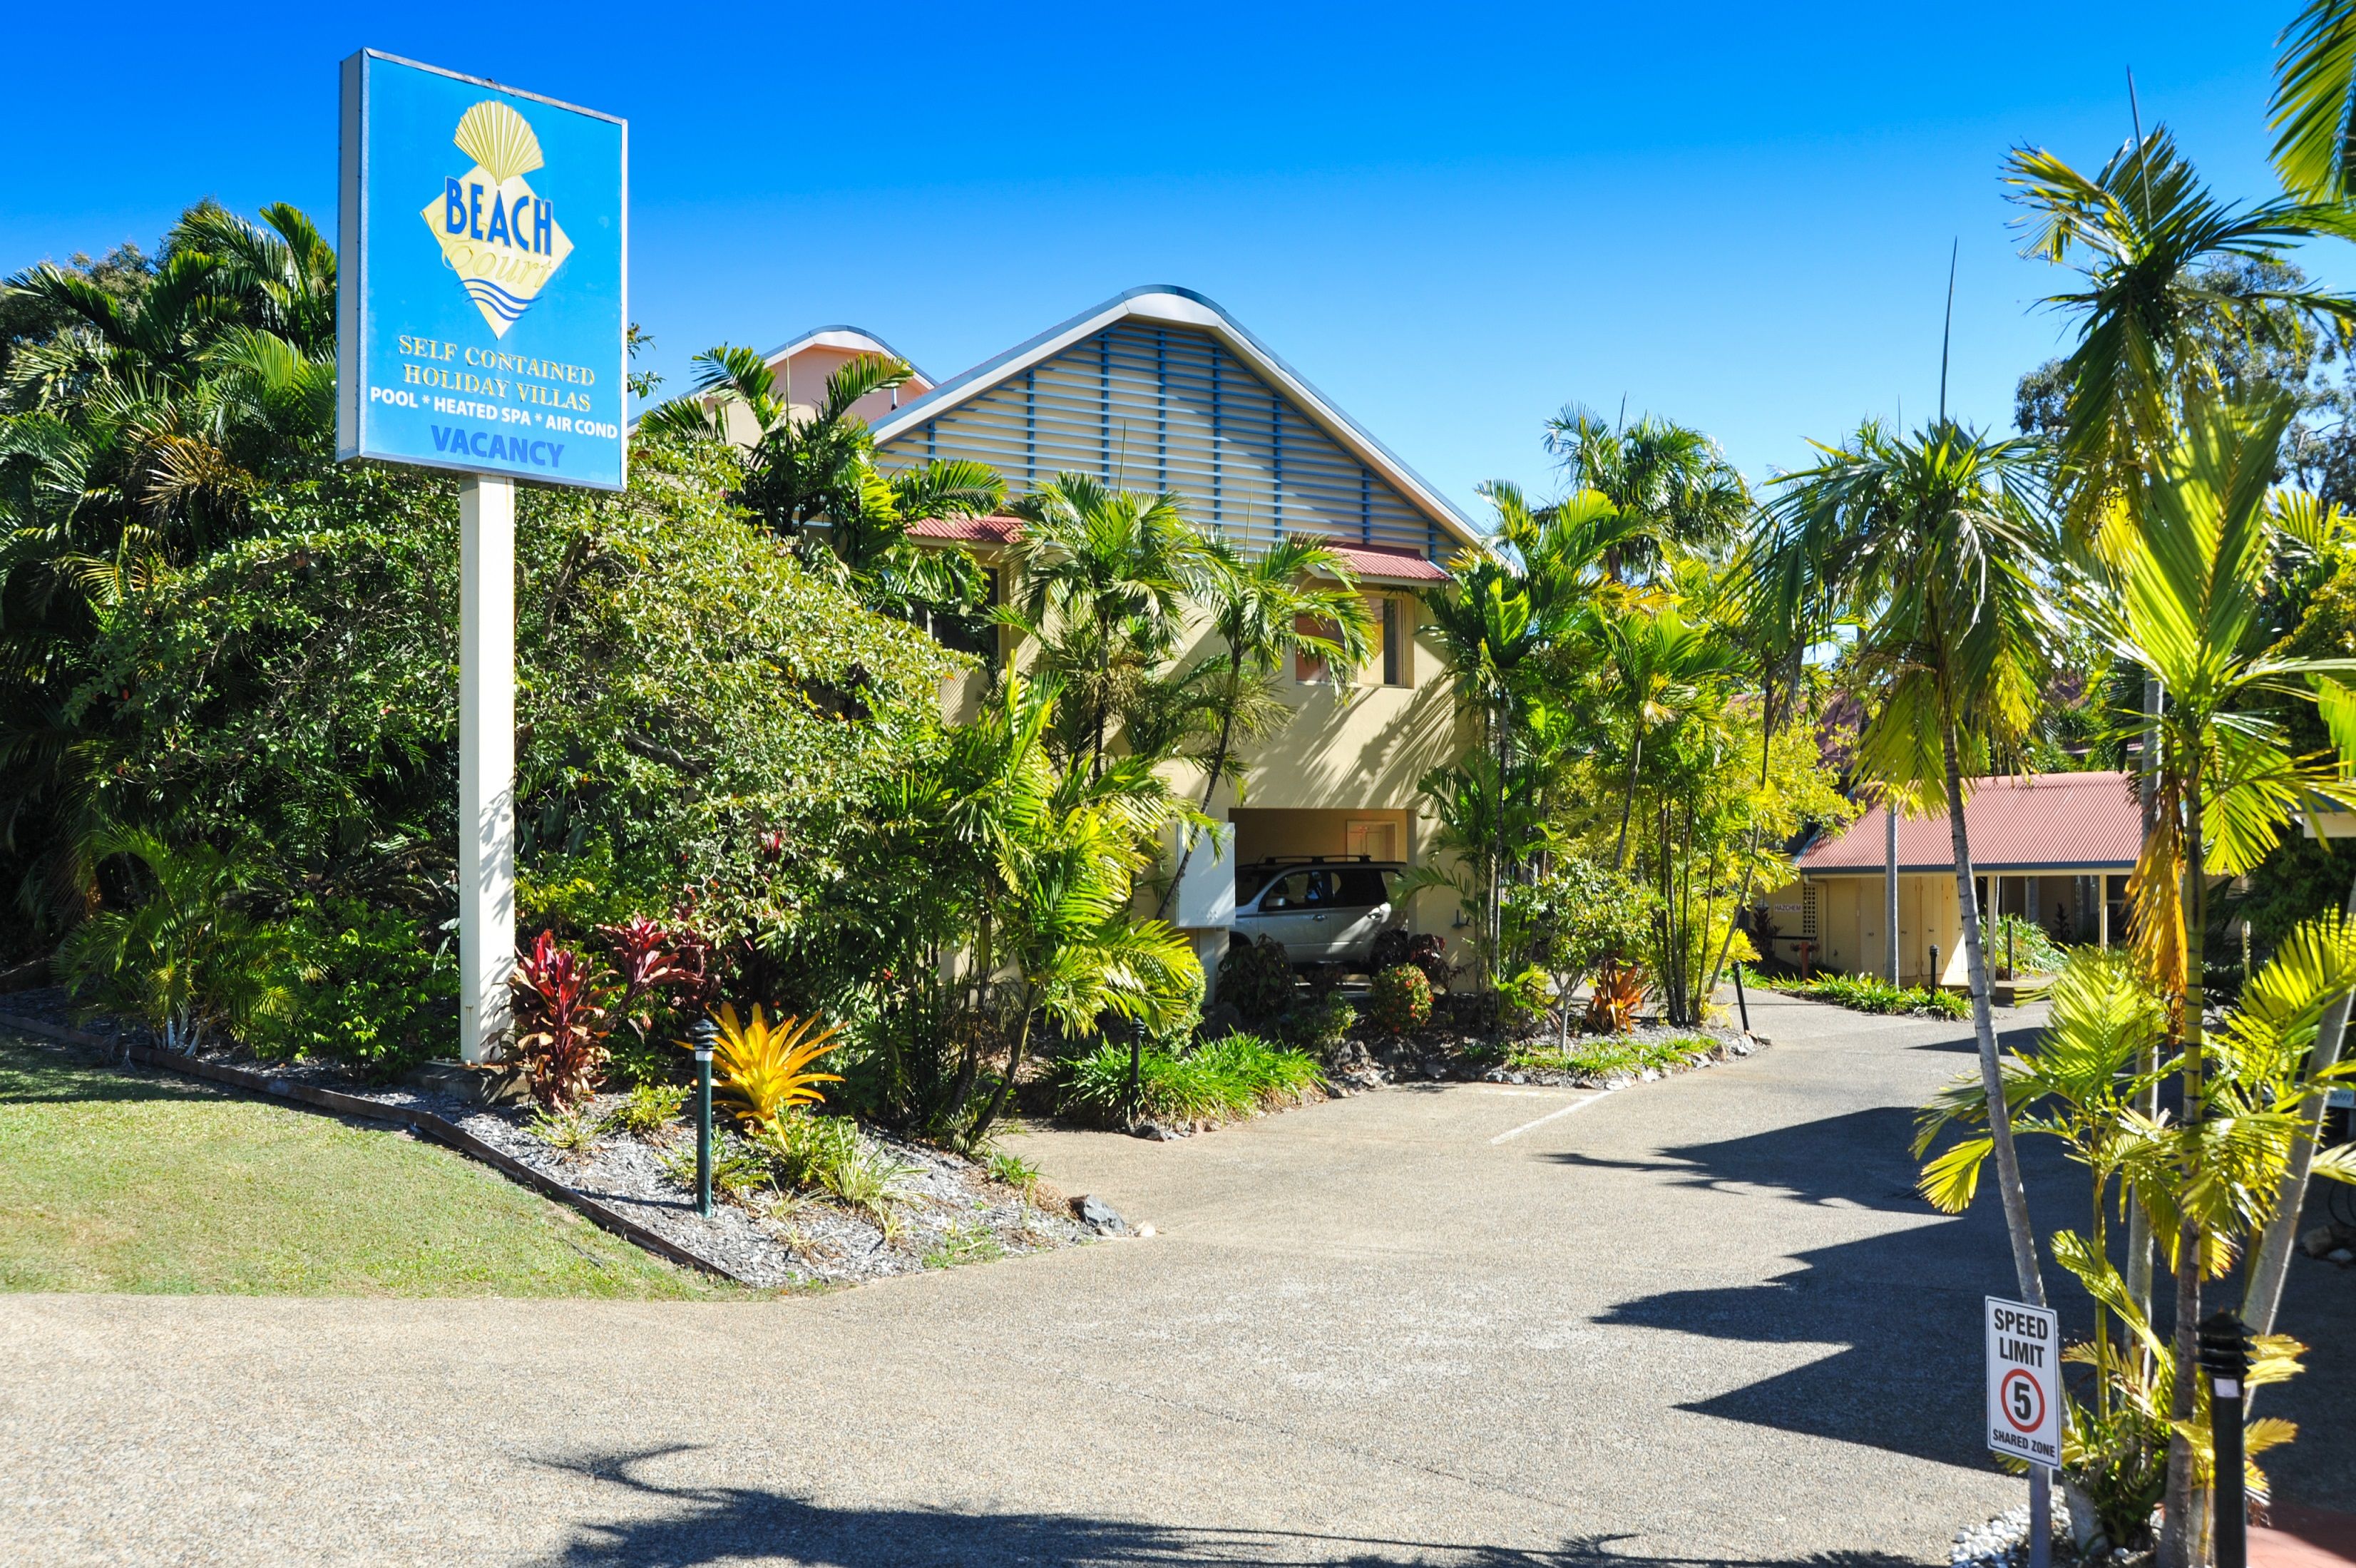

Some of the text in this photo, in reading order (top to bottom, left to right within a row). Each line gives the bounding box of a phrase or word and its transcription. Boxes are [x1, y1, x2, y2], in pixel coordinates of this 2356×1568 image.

[445, 176, 552, 257] BEACH
[432, 215, 553, 288] Court
[399, 335, 595, 386] SELF CONTAINED
[403, 363, 591, 412] HOLIDAY VILLAS
[370, 386, 618, 439] POOL HEATED SPA AIR COND
[431, 425, 565, 468] VACANCY
[1994, 1308, 2048, 1341] SPEED
[1999, 1336, 2044, 1368] LIMIT
[2014, 1381, 2032, 1420] 5
[1993, 1429, 2055, 1457] SHARED ZONE
